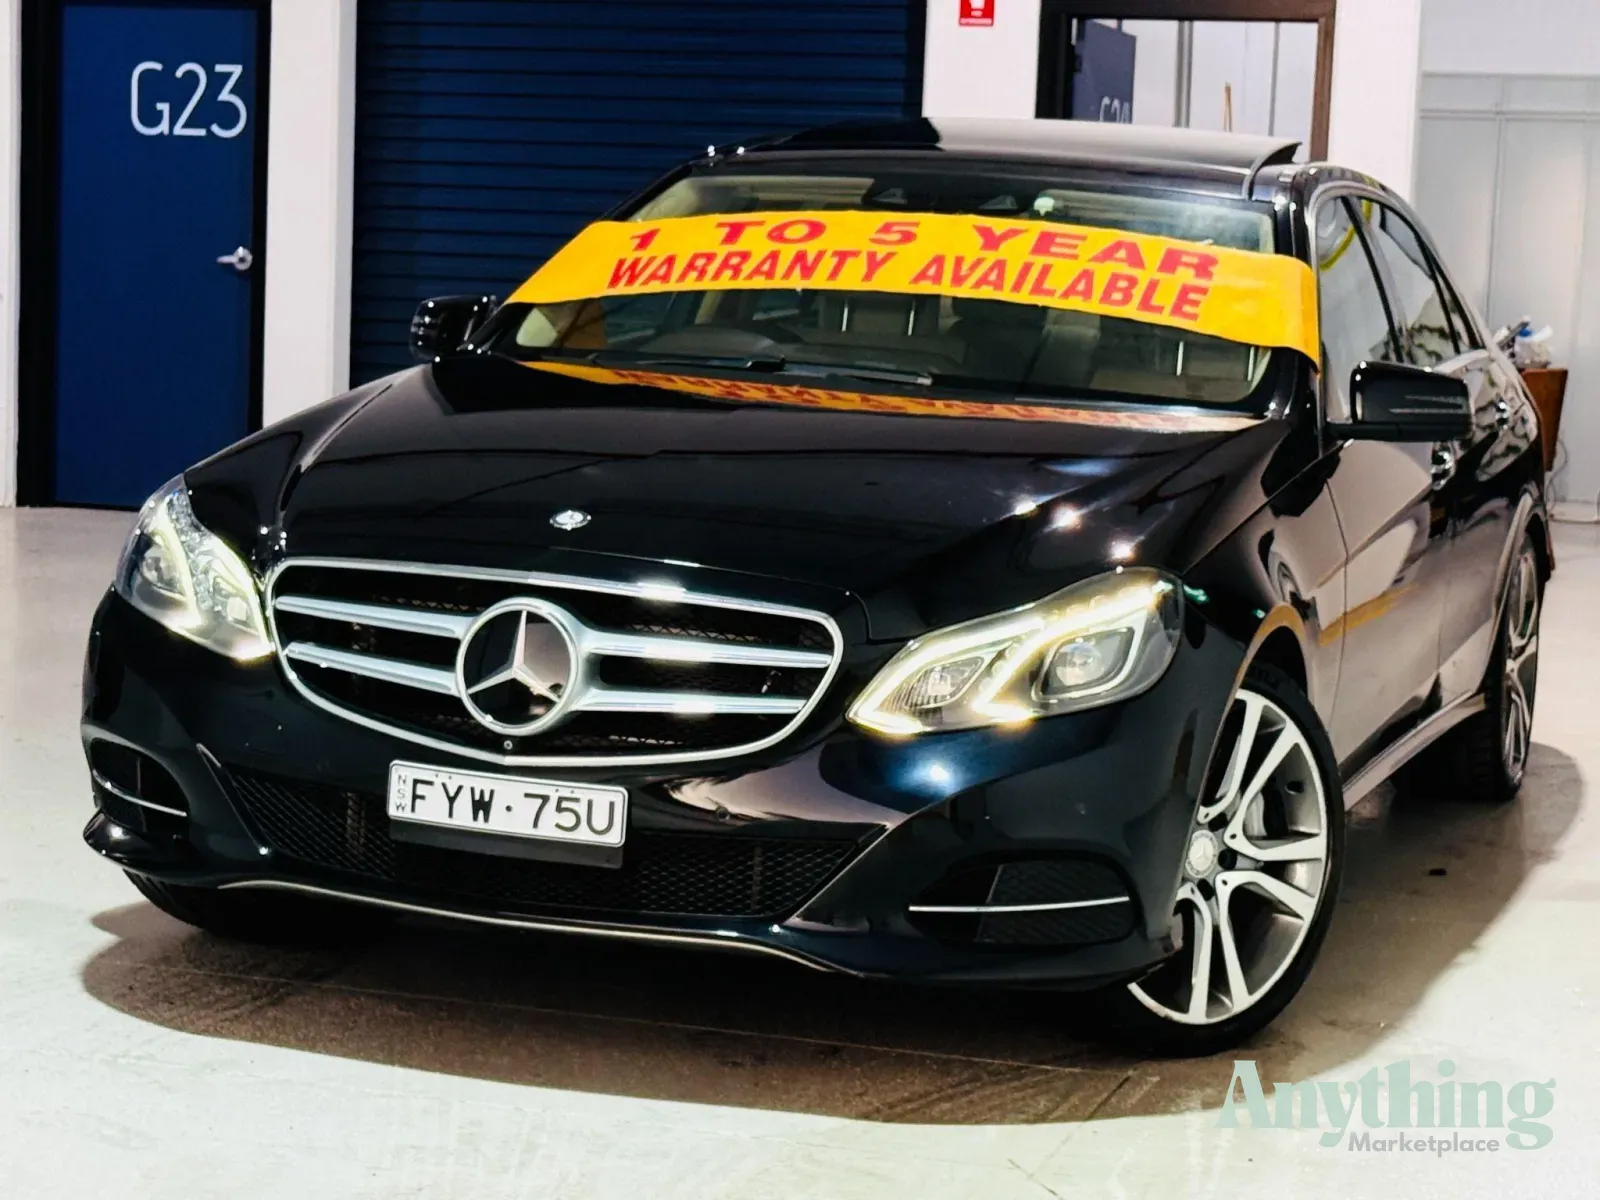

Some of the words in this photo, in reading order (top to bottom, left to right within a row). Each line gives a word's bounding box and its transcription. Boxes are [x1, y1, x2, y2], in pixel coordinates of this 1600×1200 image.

[130, 61, 248, 139] G23
[628, 228, 661, 250] 1
[716, 219, 827, 246] TO
[869, 221, 921, 245] 5
[971, 224, 1219, 281] YEAR
[607, 249, 898, 289] WARRANTY
[910, 254, 1209, 321] AVAILABLE
[395, 774, 408, 813] NSW
